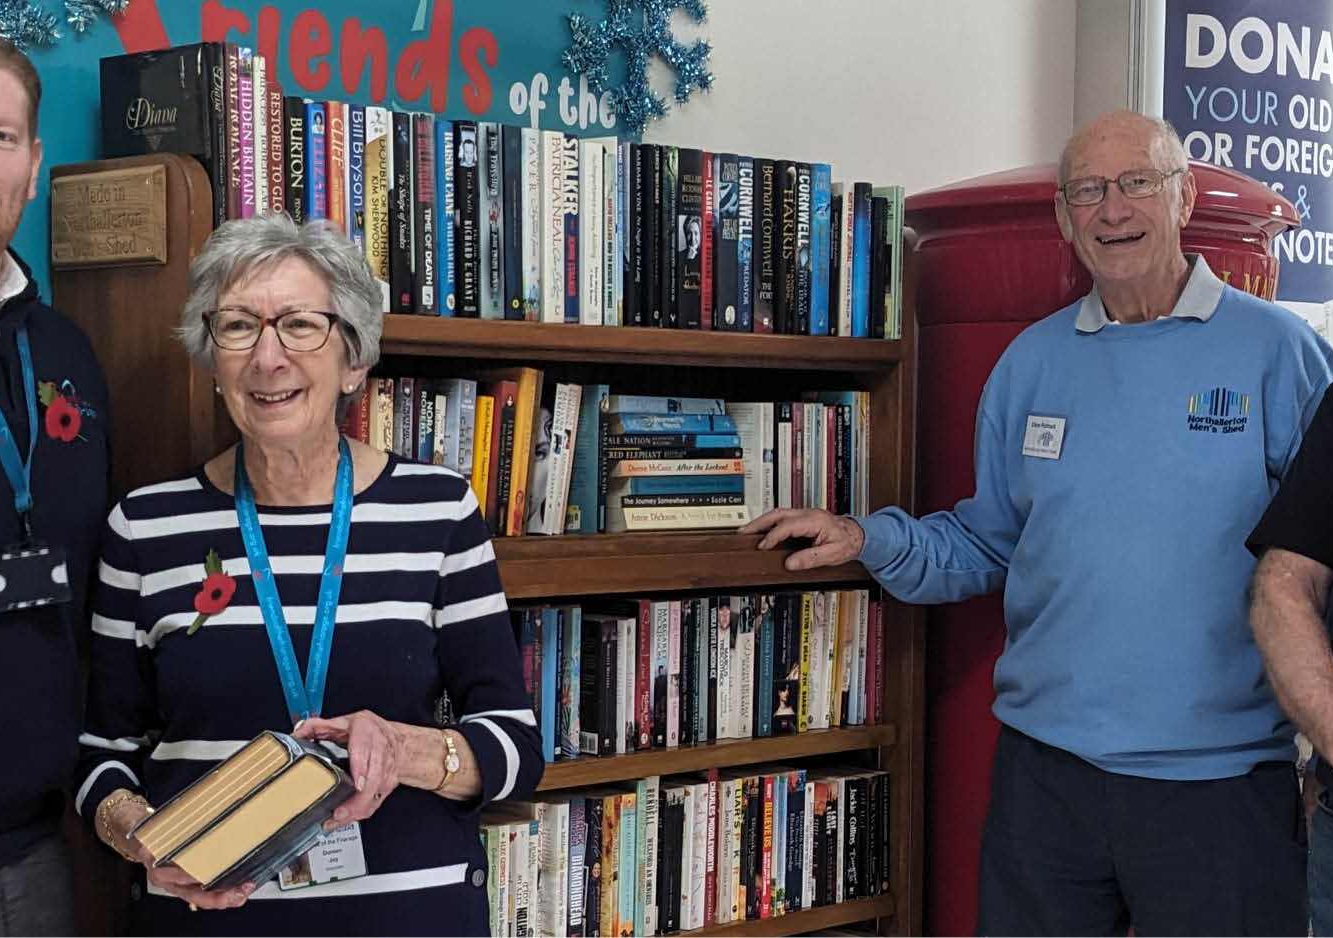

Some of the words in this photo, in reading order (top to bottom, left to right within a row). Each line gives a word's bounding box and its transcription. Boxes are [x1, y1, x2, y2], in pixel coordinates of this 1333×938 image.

[126, 98, 177, 129] Diana
[241, 80, 253, 141] HIDDEN
[509, 73, 550, 128] of
[559, 74, 616, 129] the
[1186, 84, 1278, 127] YOUR
[1289, 95, 1332, 133] OLD
[270, 92, 282, 161] RESTORED
[331, 118, 344, 168] CLIFF
[352, 110, 364, 138] Bill
[290, 117, 303, 188] BURTON
[379, 137, 387, 191] DOUBLE
[444, 132, 454, 181] RAISING
[1184, 131, 1233, 167] OR
[243, 146, 254, 205] BRITAIN
[272, 166, 282, 183] TO
[351, 142, 364, 206] Bryson
[551, 137, 562, 204] PATRICIA
[564, 137, 578, 215] STALKER
[272, 186, 283, 213] GLO
[445, 183, 454, 217] CAINE
[738, 168, 753, 242] CORNWELL
[762, 165, 774, 217] Bernard
[798, 175, 809, 247] CORNWELL
[424, 208, 432, 234] TIME
[464, 220, 473, 259] RICHARD
[552, 206, 562, 247] NEAL
[782, 189, 795, 259] HARRIS
[425, 236, 432, 250] OF
[762, 218, 774, 276] Cornwell
[425, 251, 433, 285] DEATH
[1187, 415, 1247, 426] Northallerton
[1189, 424, 1217, 433] Men's
[1223, 424, 1244, 433] Shed
[608, 437, 620, 445] ALE
[503, 457, 511, 503] ALLENDE
[646, 788, 655, 825] RENDELL
[708, 781, 716, 816] CHARLES
[734, 789, 742, 829] LIAR'S
[764, 802, 772, 835] BELIEVE
[849, 785, 857, 814] Jackie
[707, 818, 715, 872] MIDDLEWORTH
[764, 836, 772, 847] US
[849, 816, 857, 845] Collins
[570, 856, 583, 926] DIAMONDHEAD
[516, 907, 528, 937] GHTON
